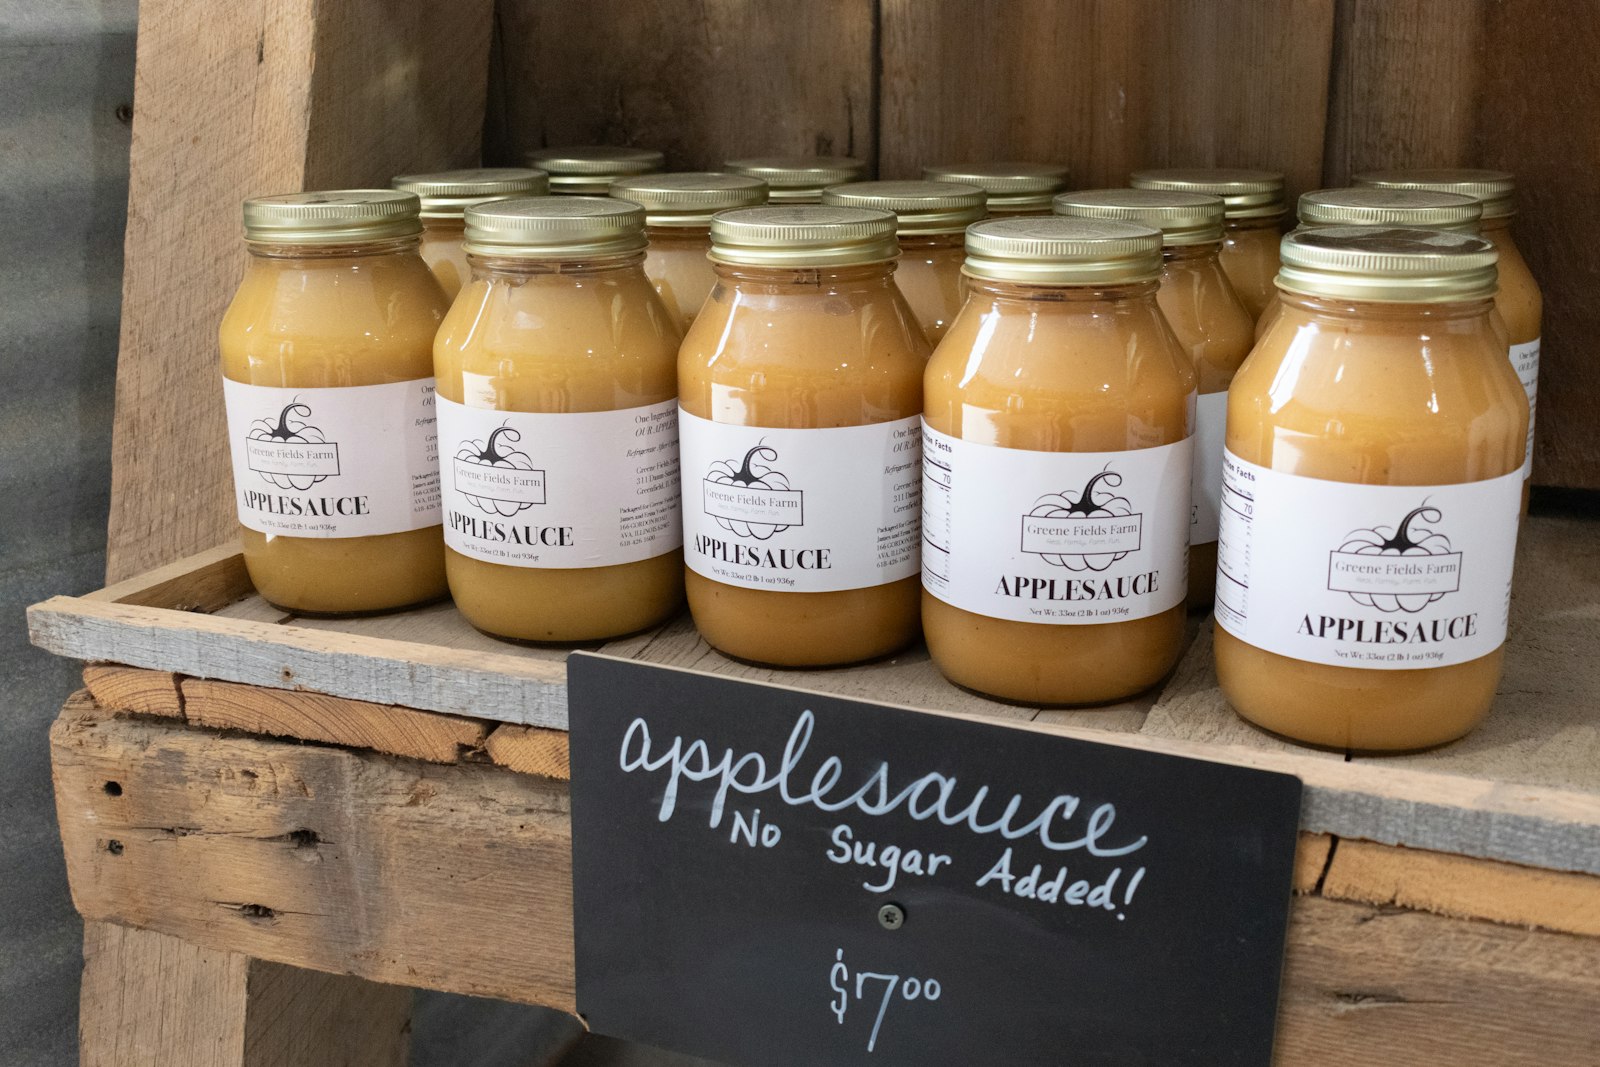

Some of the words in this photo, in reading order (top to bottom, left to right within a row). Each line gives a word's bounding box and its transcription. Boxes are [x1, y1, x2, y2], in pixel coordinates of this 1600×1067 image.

[634, 414, 650, 424] One
[635, 425, 653, 437] OUR
[893, 430, 907, 439] One
[893, 440, 910, 454] OUR
[934, 439, 952, 453] Facts
[249, 447, 275, 458] Greene
[276, 449, 304, 459] Fields
[306, 450, 334, 459] Farm
[636, 465, 656, 475] Greene
[1236, 466, 1256, 482] Facts
[456, 466, 481, 481] Greene
[483, 472, 511, 485] Fields
[514, 476, 541, 487] Farm
[636, 476, 648, 485] 311
[943, 473, 952, 485] 70
[893, 481, 912, 492] Greene
[243, 489, 370, 517] APPLESAUCE
[706, 488, 735, 503] Greene
[737, 494, 767, 507] Fields
[769, 497, 798, 508] Farm
[893, 493, 905, 503] 311
[619, 504, 642, 514] Packaged
[1244, 503, 1253, 515] 70
[448, 509, 574, 547] APPLESAUCE
[876, 524, 899, 534] Packaged
[1027, 524, 1070, 536] Greene
[1073, 524, 1107, 536] Fields
[1110, 523, 1138, 535] Farm
[876, 535, 891, 543] James
[886, 537, 910, 549] GORDON
[521, 553, 540, 562] 936g
[694, 533, 831, 570] APPLESAUCE
[1335, 561, 1382, 575] Greene
[1386, 564, 1423, 575] Fields
[1426, 563, 1457, 574] Farm
[730, 571, 745, 580] 33oz
[776, 577, 795, 587] 936g
[994, 570, 1159, 601] APPLESAUCE
[1029, 607, 1042, 616] Net
[1043, 608, 1057, 617] Wt:
[1058, 609, 1076, 617] 33oz
[1077, 609, 1086, 618] (2
[1100, 608, 1111, 617] oz)
[1111, 606, 1130, 616] 936g
[1297, 613, 1478, 644] APPLESAUCE
[1334, 649, 1348, 659] Net
[1366, 652, 1385, 661] 33oz
[1387, 652, 1396, 662] (2
[1396, 652, 1404, 661] lb
[1411, 652, 1424, 661] oz)
[1425, 651, 1445, 661] 936g
[619, 709, 1149, 859] applesauce
[729, 808, 783, 850] No
[826, 825, 953, 894] Sugar
[975, 847, 1147, 922] Added!
